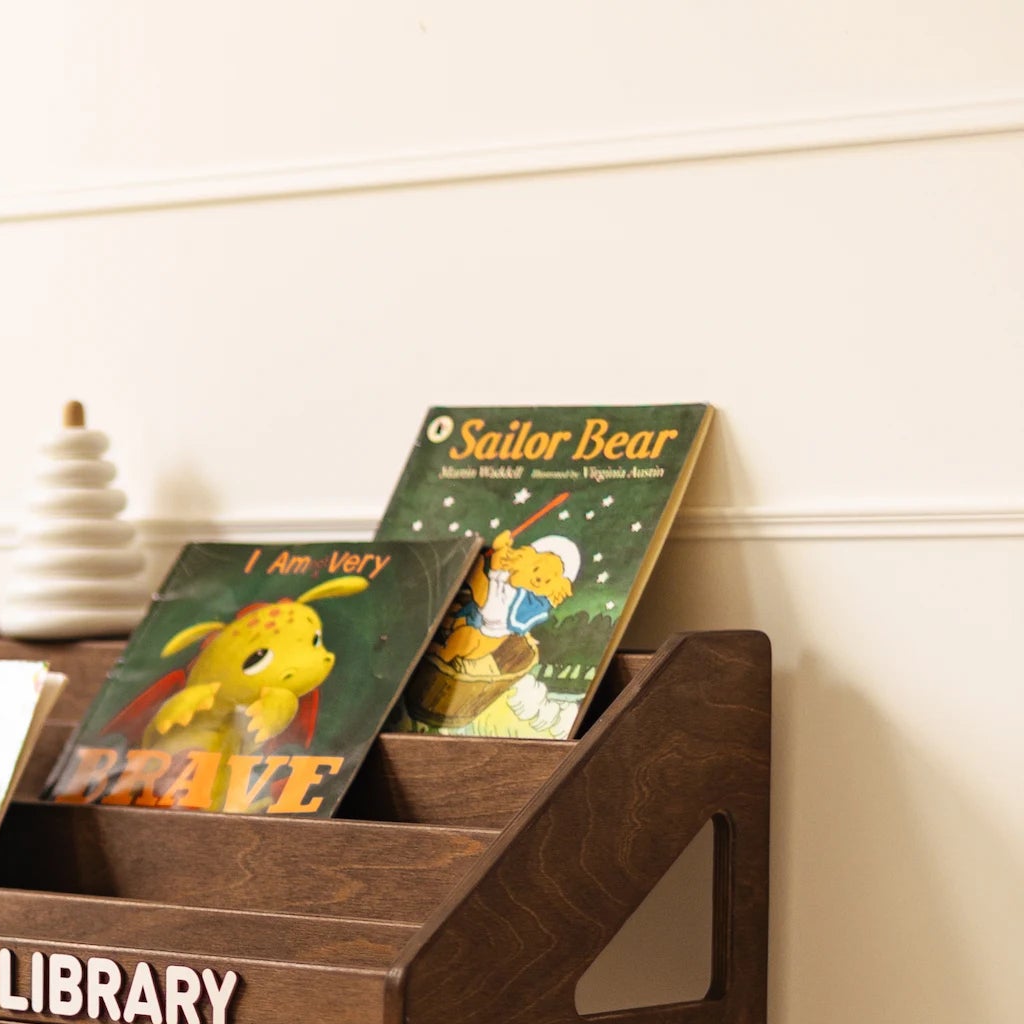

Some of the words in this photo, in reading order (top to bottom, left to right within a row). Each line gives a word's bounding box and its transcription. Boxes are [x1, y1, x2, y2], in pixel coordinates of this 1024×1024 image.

[449, 418, 572, 460] Sailor
[572, 418, 678, 460] Bear
[479, 465, 525, 480] Waddell
[583, 465, 626, 482] Virginia
[627, 465, 665, 478] Austin
[244, 549, 261, 574] I
[266, 551, 311, 575] Am
[328, 551, 392, 579] Very
[55, 745, 344, 813] BRAVE
